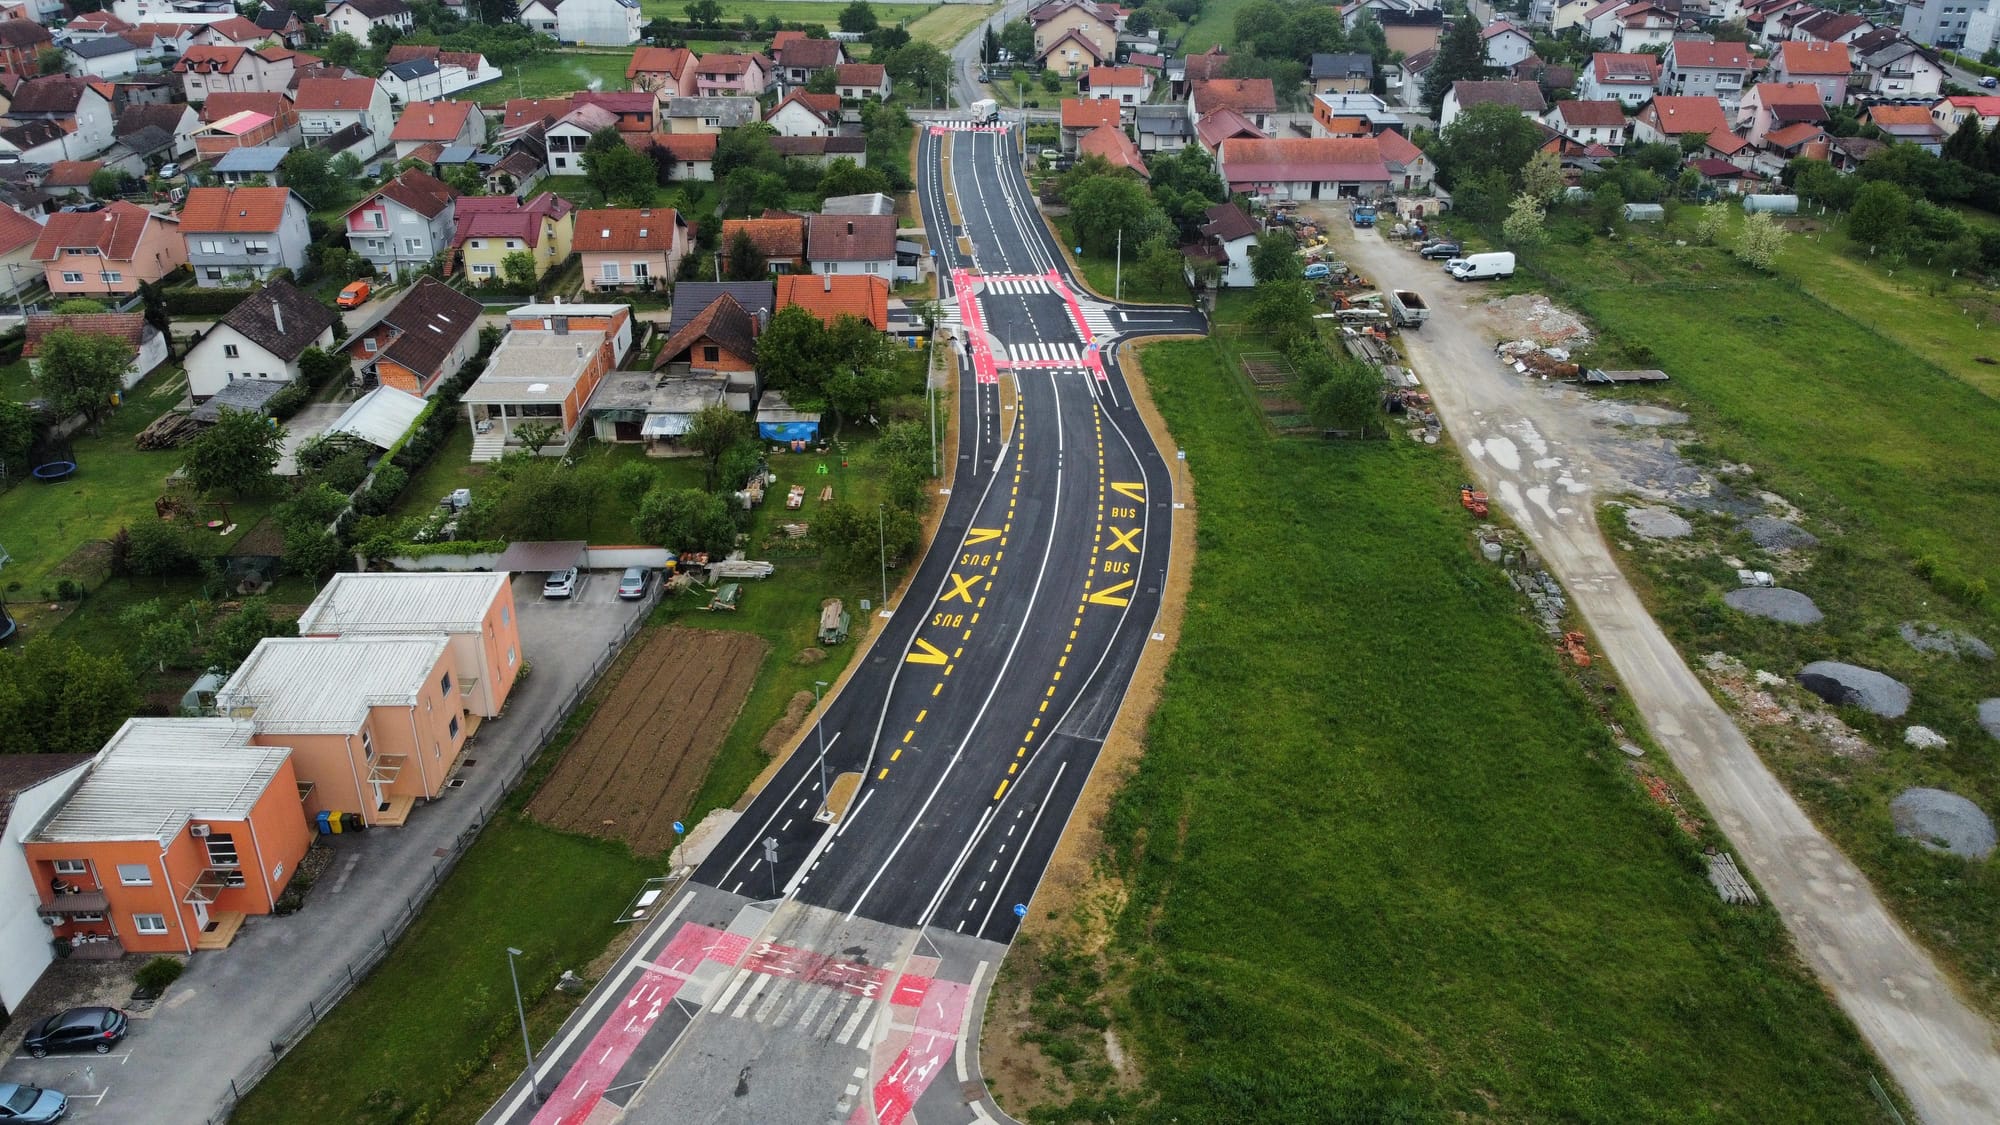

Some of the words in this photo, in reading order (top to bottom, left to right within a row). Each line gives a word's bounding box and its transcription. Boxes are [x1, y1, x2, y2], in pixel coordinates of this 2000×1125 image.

[1112, 507, 1136, 519] BUS
[961, 553, 991, 567] BUS
[1104, 561, 1130, 574] BUS
[932, 613, 964, 628] BUS
